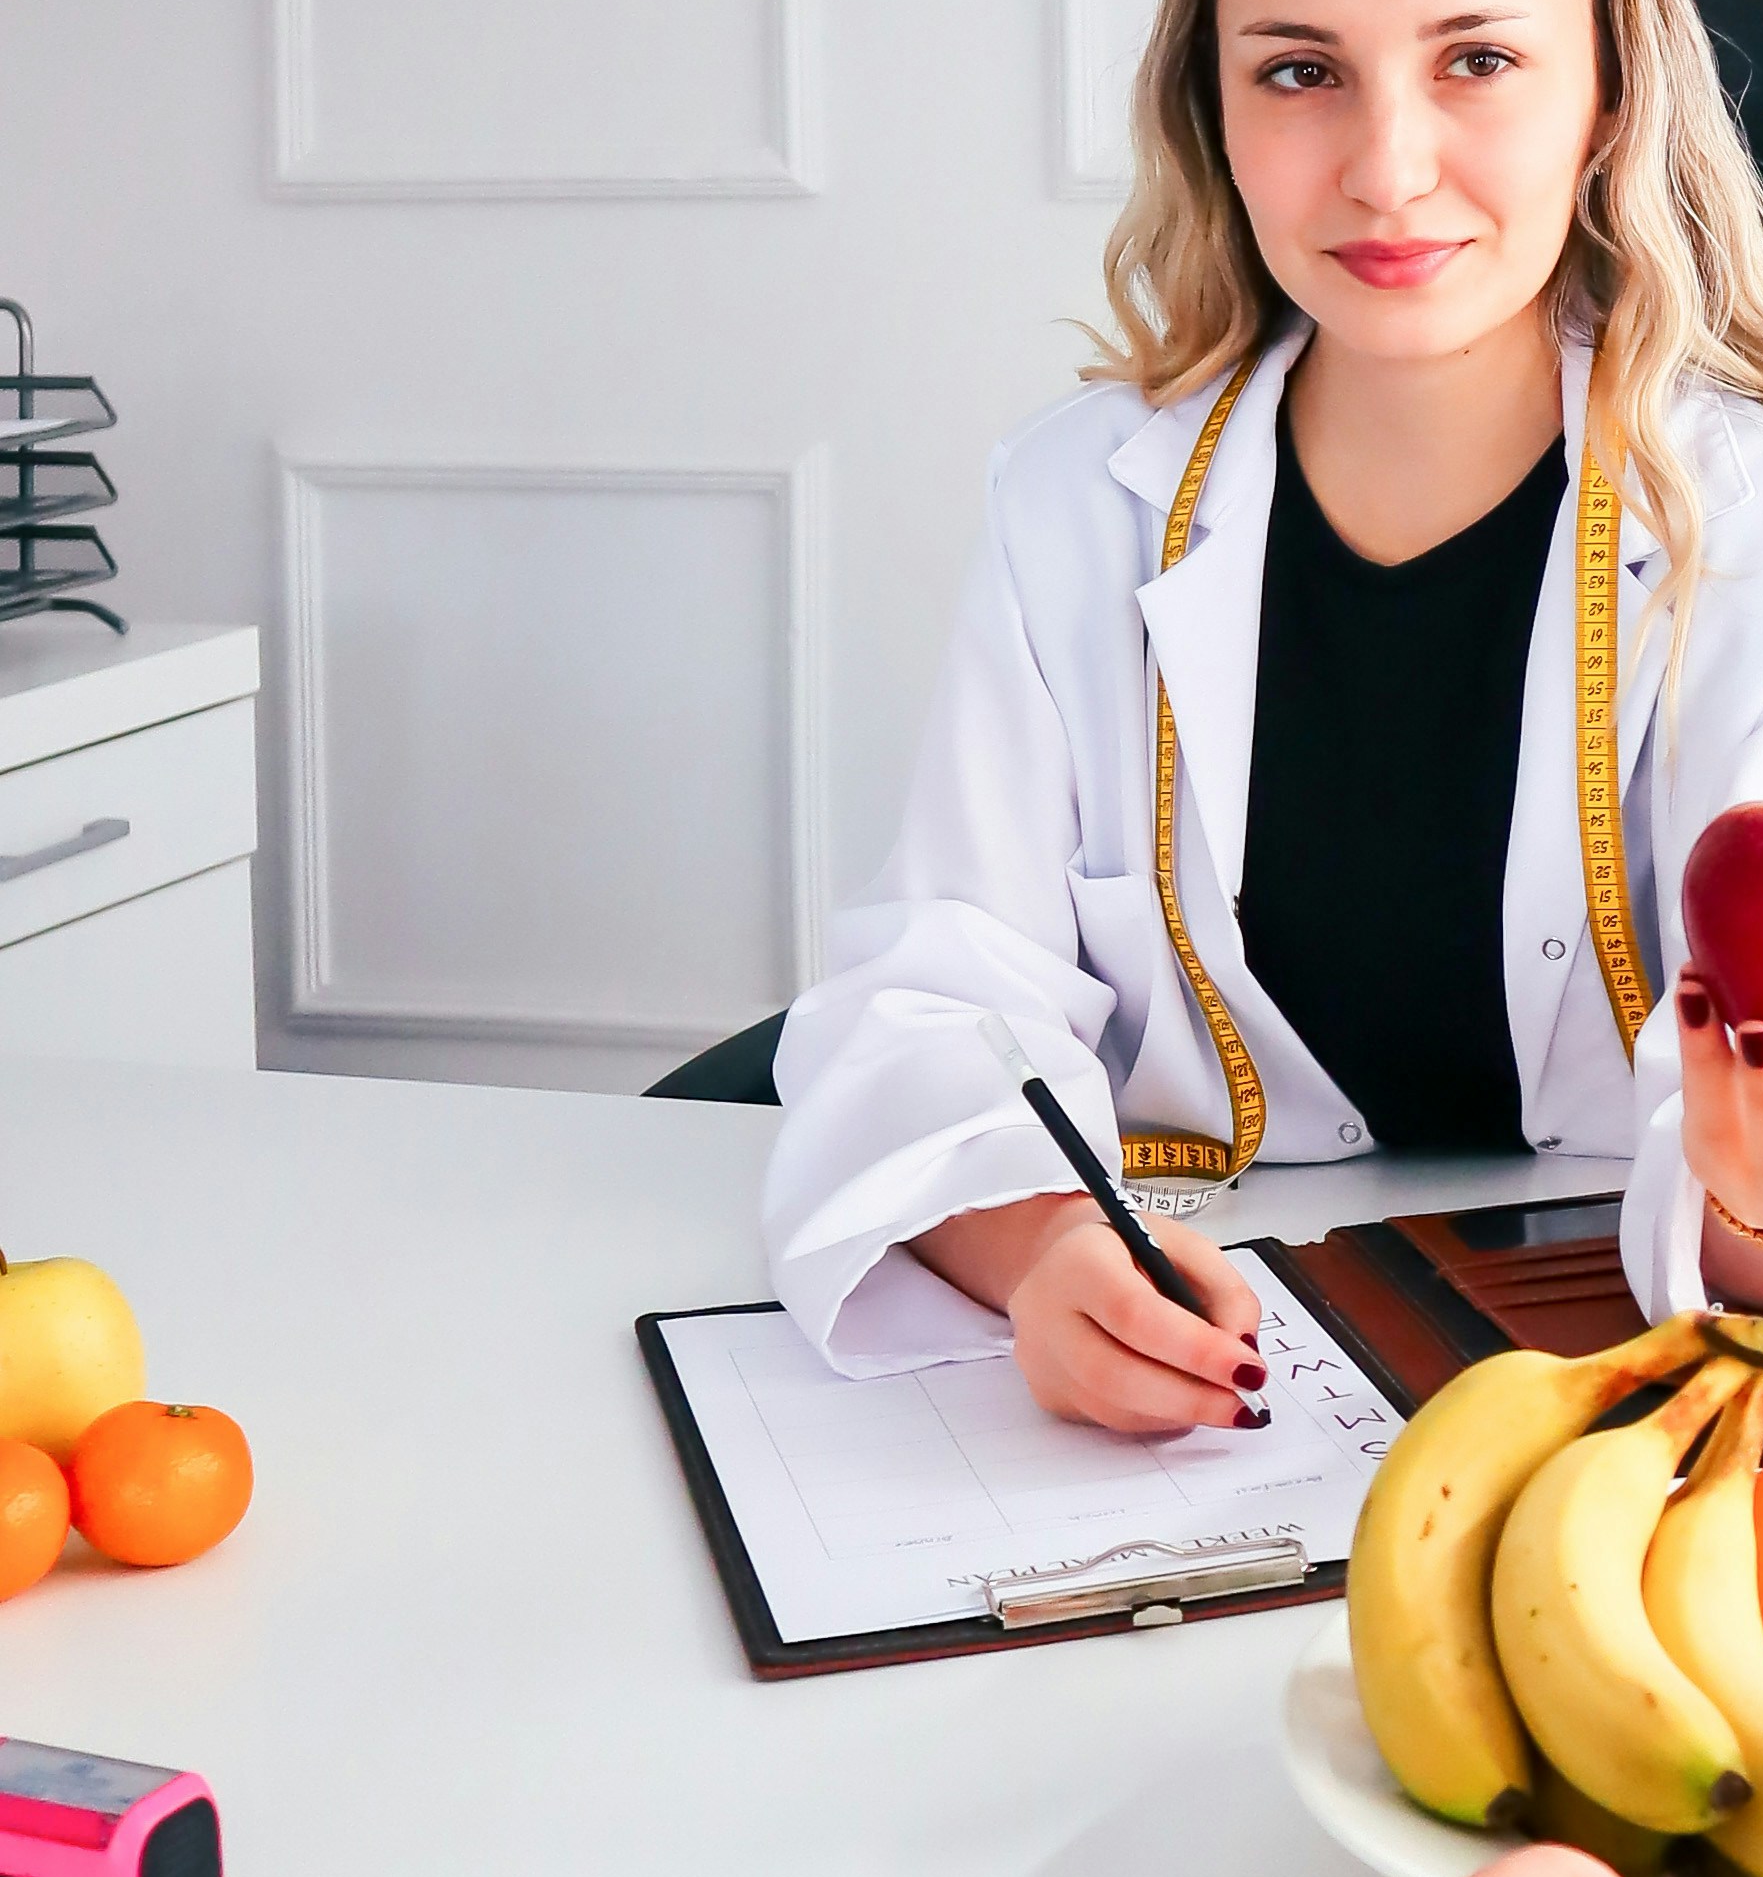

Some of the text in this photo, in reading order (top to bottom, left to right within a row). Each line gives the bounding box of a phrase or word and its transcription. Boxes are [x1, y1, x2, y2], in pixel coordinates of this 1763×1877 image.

[1591, 498, 1608, 511] 66
[1589, 523, 1606, 537] 65
[1589, 549, 1606, 563] 64
[1588, 575, 1605, 589] 63
[1588, 602, 1605, 616] 62
[1590, 628, 1603, 642] 61
[1586, 655, 1603, 669] 60
[1587, 681, 1604, 696] 59
[1586, 708, 1604, 724] 58
[1587, 735, 1604, 750] 57
[1587, 761, 1604, 775] 56
[1588, 787, 1605, 802] 55
[1589, 813, 1606, 827] 54
[1592, 840, 1609, 854] 53
[1595, 865, 1612, 879] 52
[1599, 889, 1612, 903] 51
[1602, 914, 1618, 928] 50
[1606, 938, 1622, 950] 49
[1610, 957, 1627, 968] 48
[1616, 975, 1632, 986] 47
[1622, 993, 1638, 1003] 46
[1628, 1010, 1644, 1021] 45
[1156, 1198, 1171, 1210] 15
[1181, 1197, 1196, 1208] 16
[1268, 1338, 1307, 1356] T
[1291, 1359, 1342, 1380] W
[1316, 1385, 1353, 1403] T
[1333, 1407, 1387, 1430] M
[1172, 1521, 1306, 1551] WEEKL
[1046, 1548, 1149, 1571] MAL
